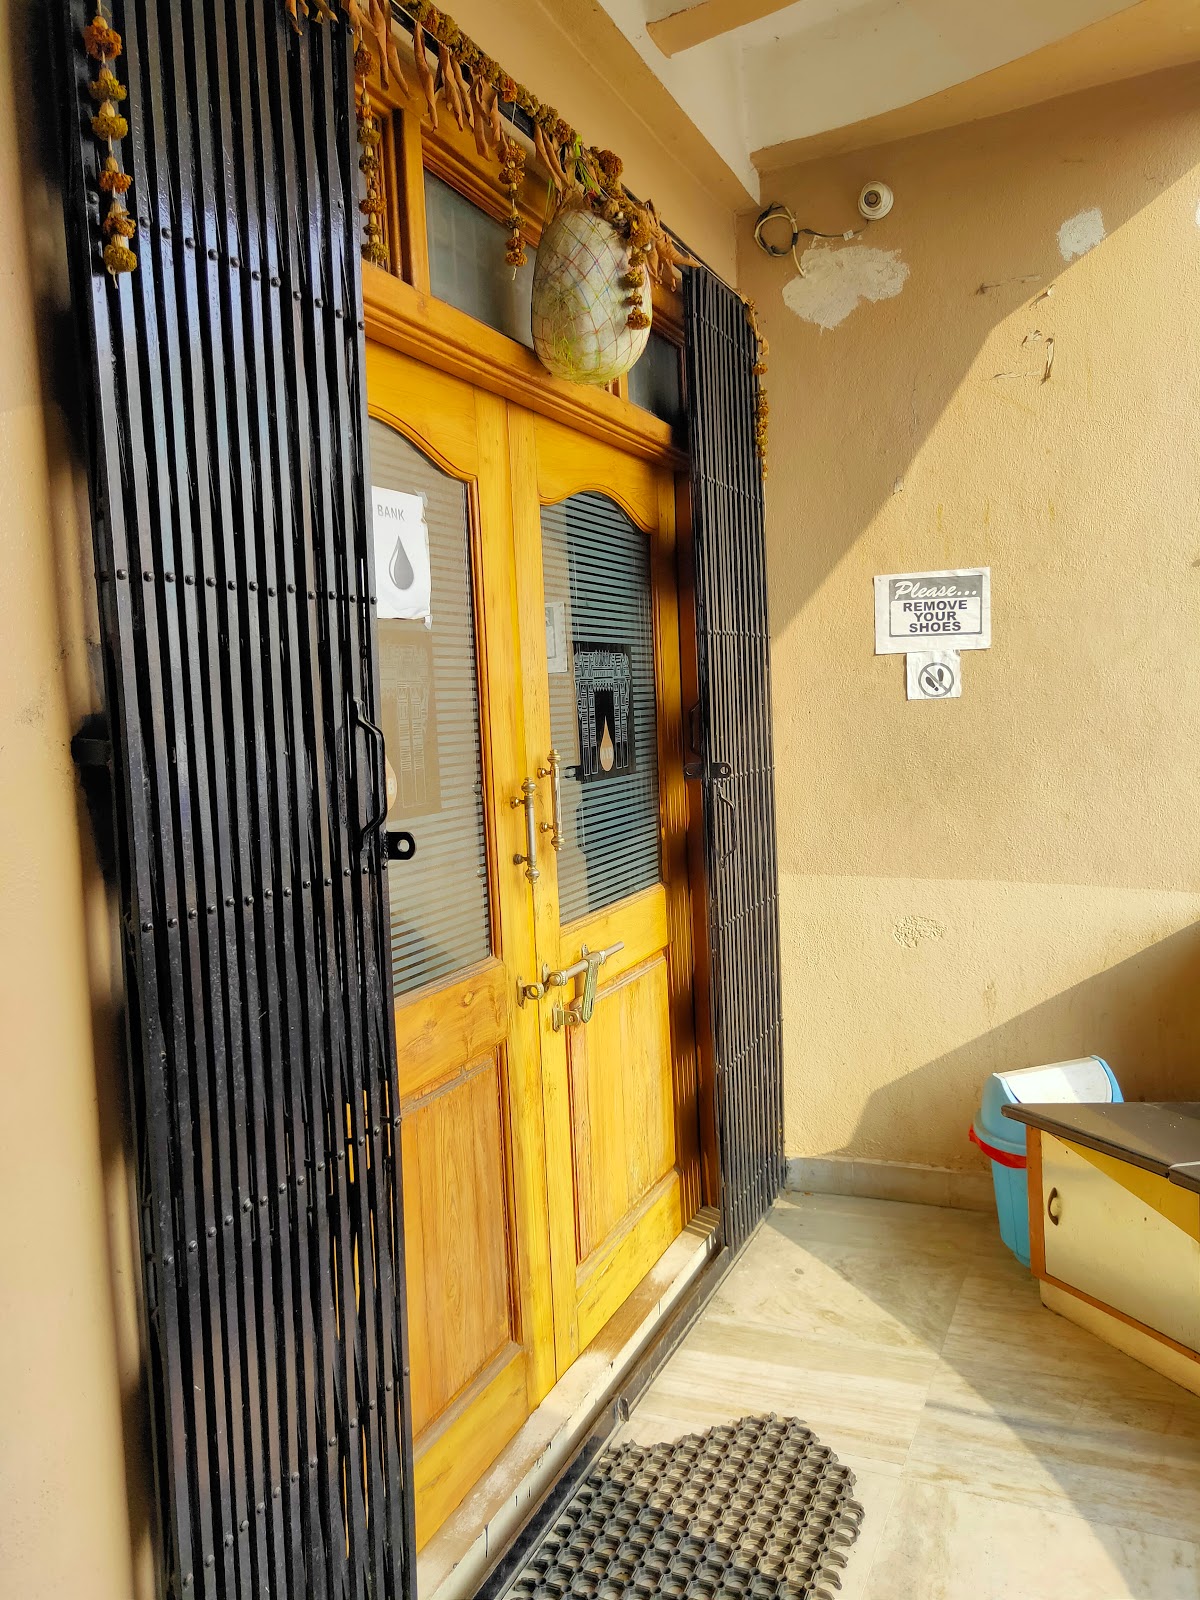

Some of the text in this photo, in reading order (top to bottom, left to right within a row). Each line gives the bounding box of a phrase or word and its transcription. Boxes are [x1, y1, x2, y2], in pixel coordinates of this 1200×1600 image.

[377, 504, 405, 521] BANK
[895, 581, 977, 599] Please...
[903, 599, 968, 612] REMOVE
[914, 611, 957, 622] YOUR
[909, 621, 962, 633] SHOES
